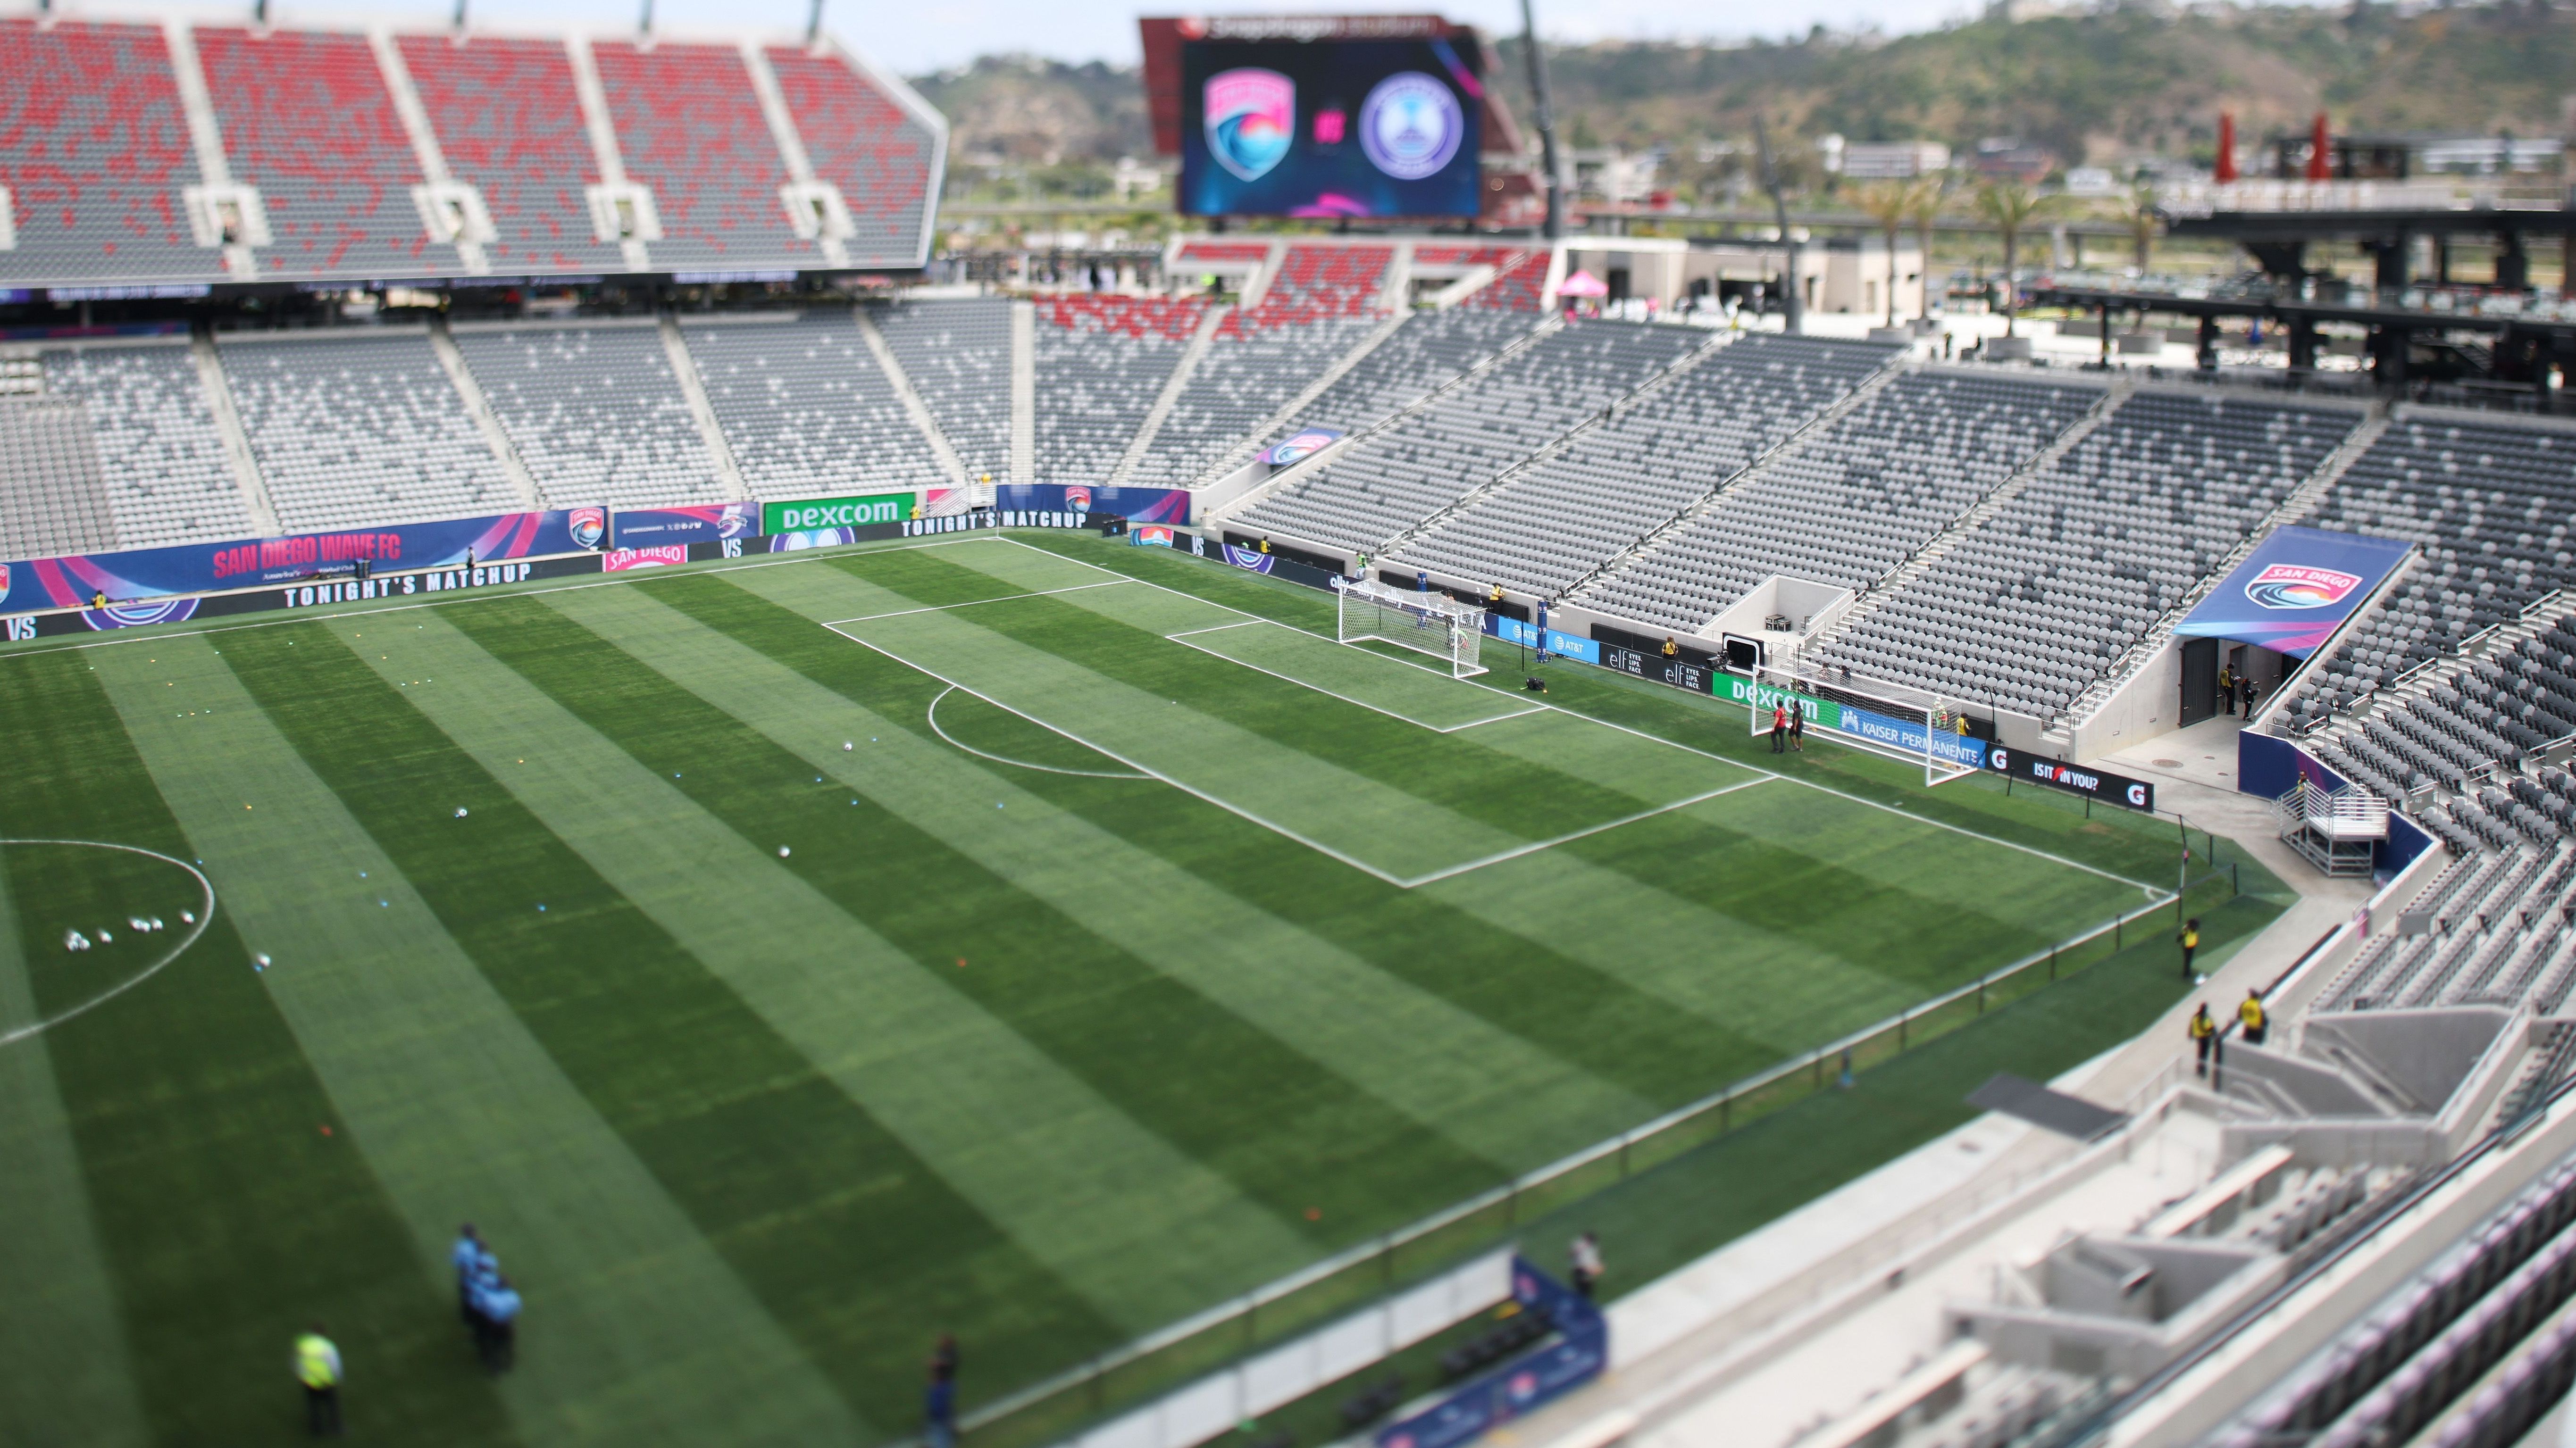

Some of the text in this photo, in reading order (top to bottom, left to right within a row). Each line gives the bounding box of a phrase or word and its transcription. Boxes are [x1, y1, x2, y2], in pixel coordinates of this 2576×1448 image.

[902, 511, 1087, 537] TONIGHT'S MATCHUP
[213, 533, 401, 579] SAN DIEGO WAVE FC
[721, 538, 742, 559] VS
[1191, 535, 1204, 556] VS
[610, 547, 681, 570] SAN DIEGO
[284, 563, 531, 608] TONIGHT'S MATCHUP
[1330, 575, 1349, 594] ally
[2269, 568, 2351, 589] SAN DIEGO
[7, 616, 37, 641] VS
[1565, 641, 1584, 653] AT&T
[1629, 653, 1642, 662] EYES.
[1629, 659, 1641, 667] LIPS.
[1629, 666, 1642, 674] FACE.
[1686, 668, 1700, 676] EYES.
[1686, 674, 1699, 682] LIPS.
[1686, 681, 1700, 690] FACE.
[1863, 721, 1899, 742] KAISER
[1991, 749, 2007, 770] G
[2071, 773, 2099, 791] YOU?
[2127, 785, 2145, 806] G
